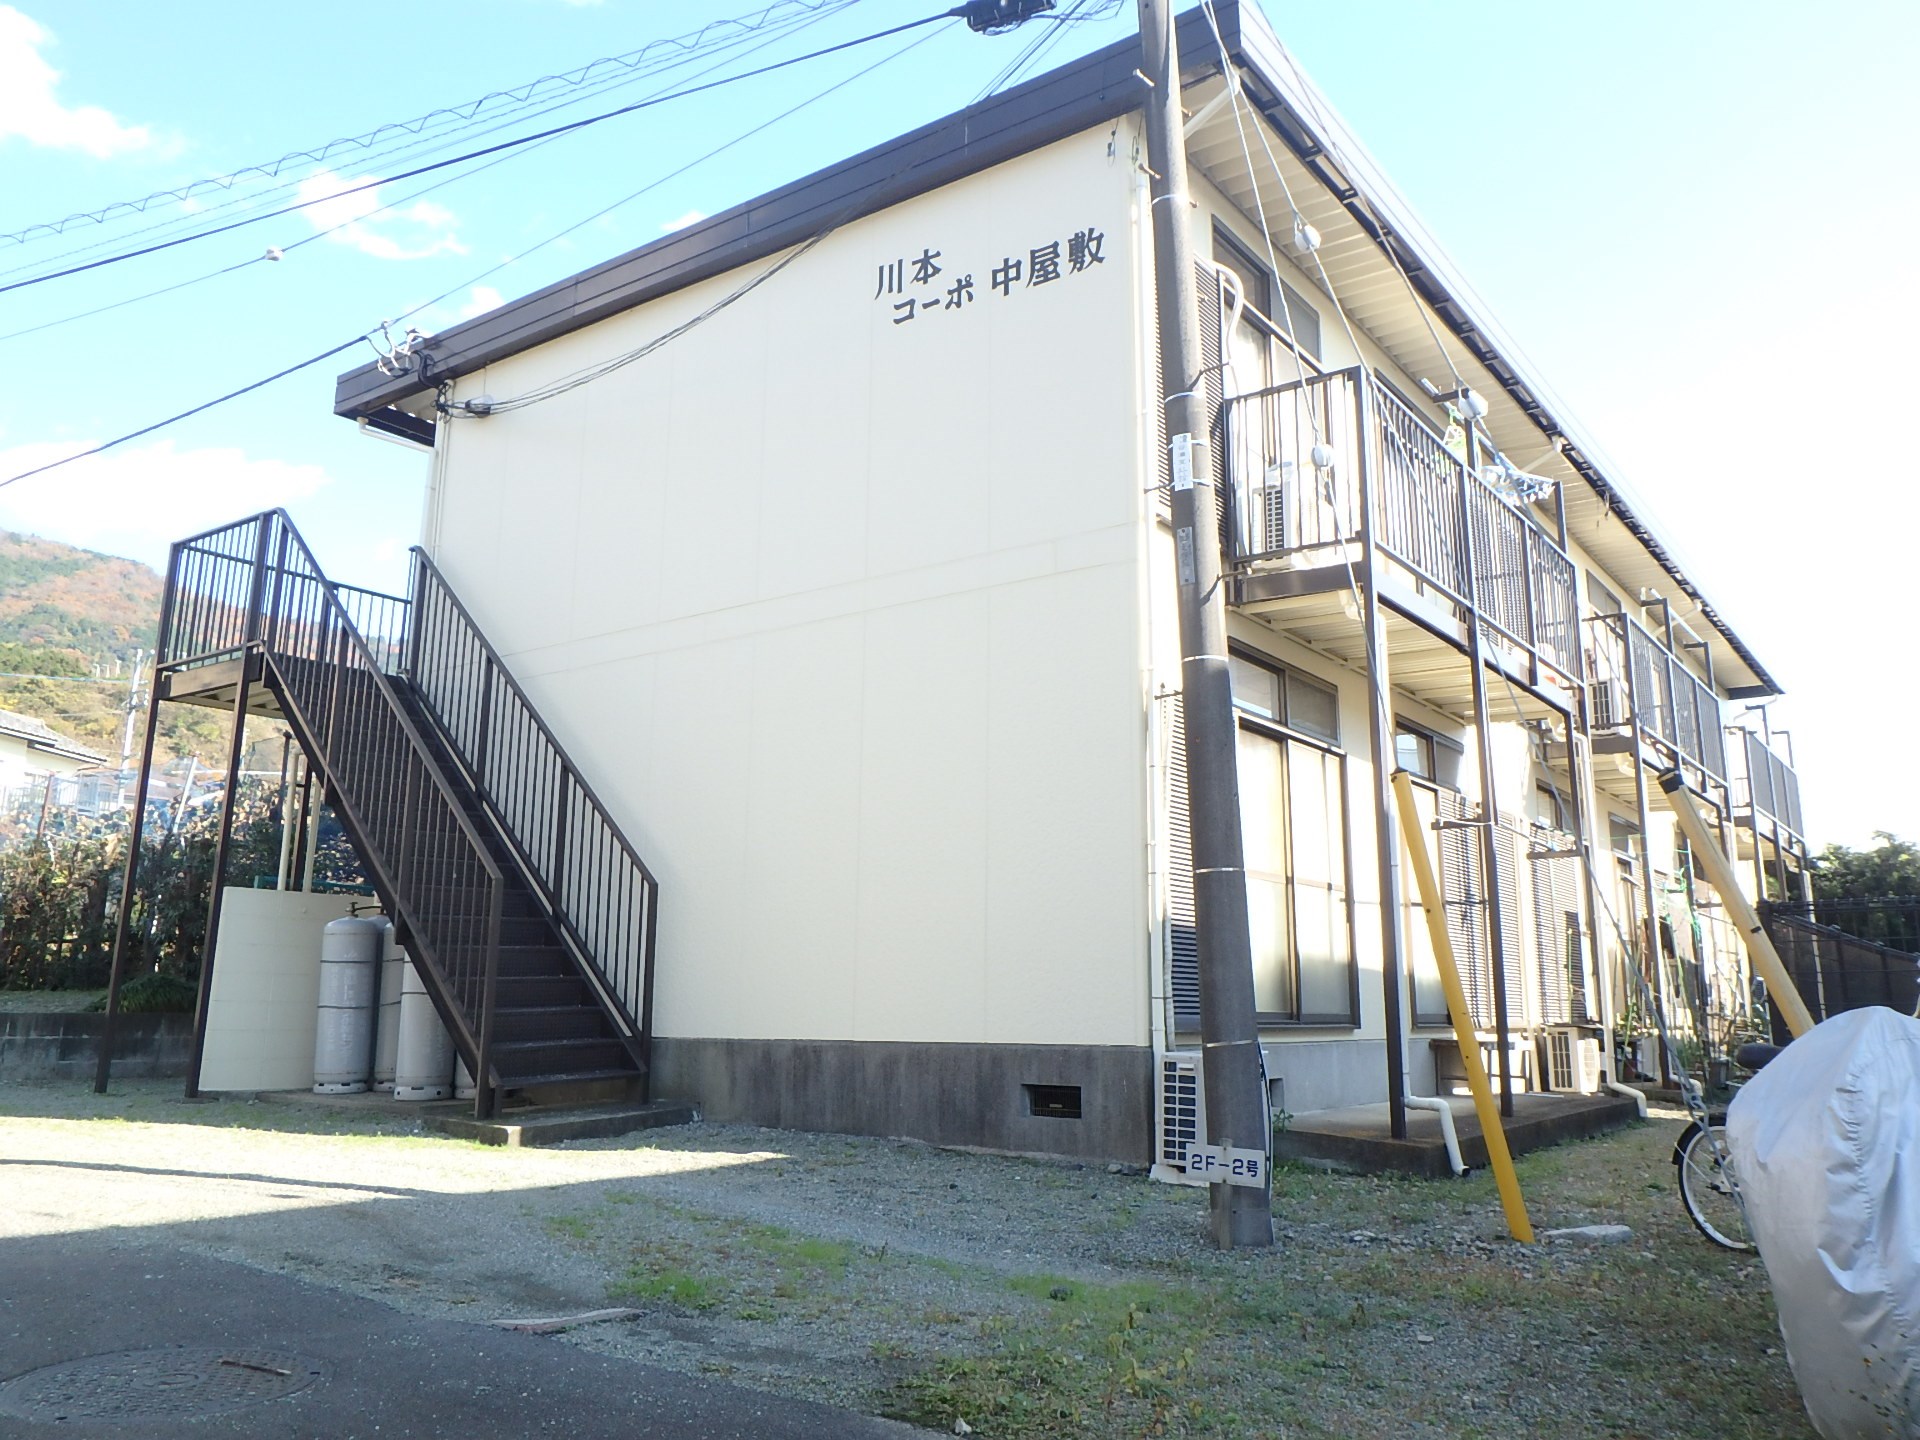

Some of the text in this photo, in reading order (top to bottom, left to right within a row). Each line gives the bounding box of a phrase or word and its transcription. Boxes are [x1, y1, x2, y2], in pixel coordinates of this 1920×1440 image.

[874, 248, 943, 300] 川本
[892, 227, 1106, 325] コーポ 中屋敷
